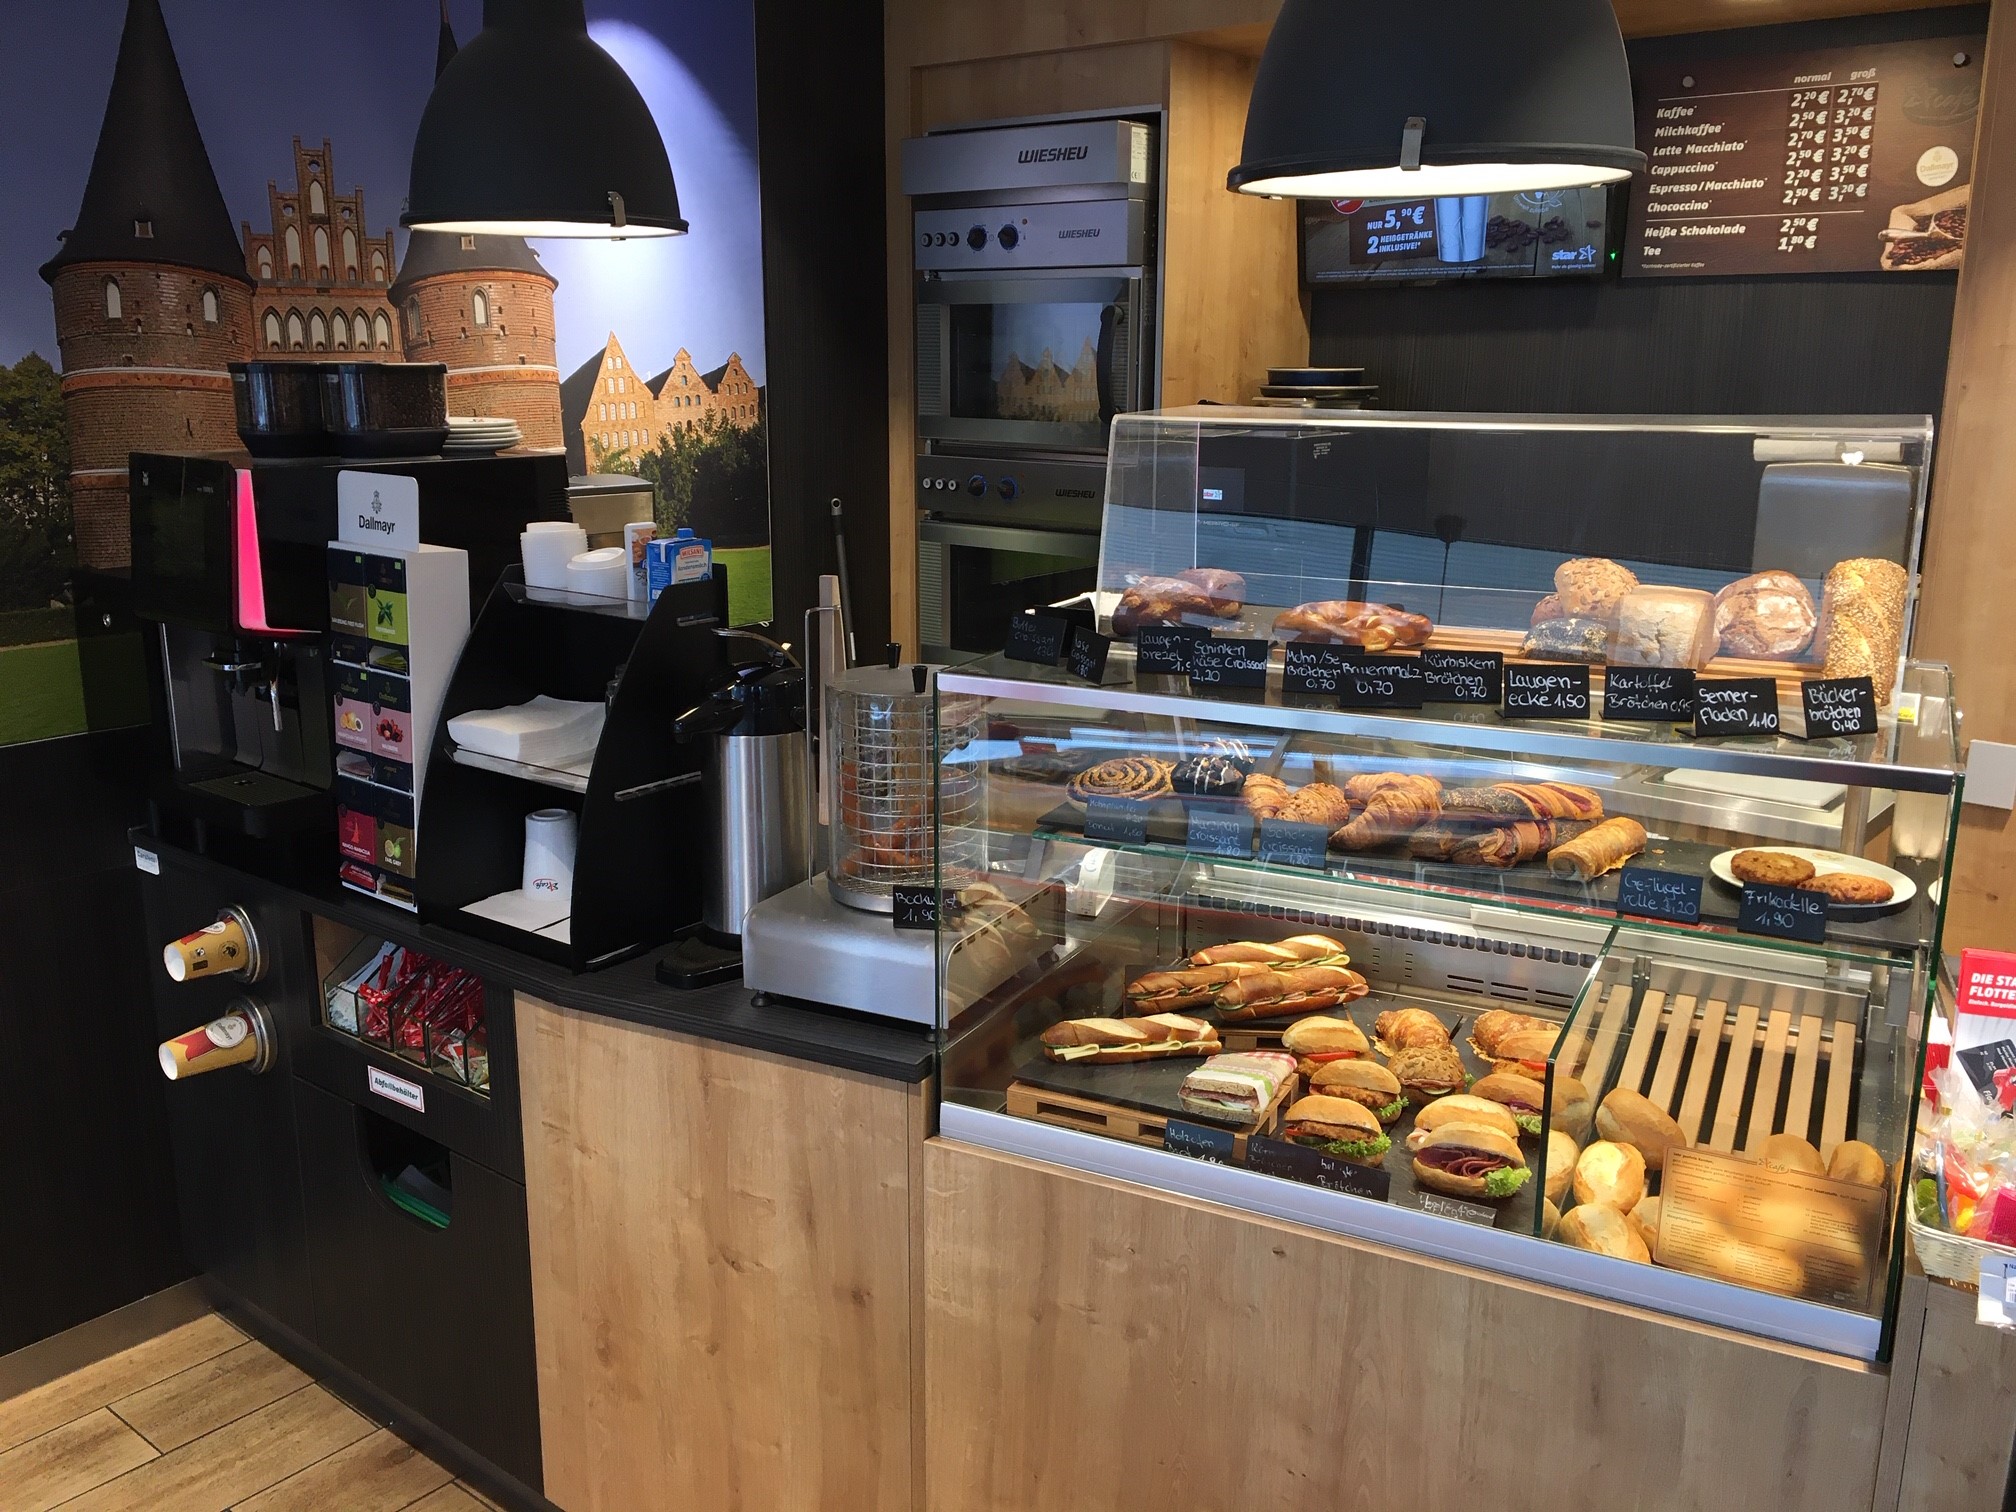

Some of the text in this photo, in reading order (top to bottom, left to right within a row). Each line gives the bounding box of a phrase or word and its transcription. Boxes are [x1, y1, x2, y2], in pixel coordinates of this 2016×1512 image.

[1794, 68, 1876, 84] normal groß
[1018, 145, 1088, 164] WIESHEU
[1653, 145, 1682, 157] Latte
[1367, 221, 1383, 230] NUR
[1644, 226, 1678, 239] Heiße
[1680, 224, 1746, 237] Schokolade
[1058, 228, 1101, 239] WIESHEU
[1367, 236, 1379, 254] 2
[1643, 246, 1662, 256] Tee
[1552, 249, 1578, 260] star
[1055, 488, 1096, 499] WIESHEU
[359, 515, 395, 535] Dallmayr
[1194, 640, 1246, 658] Schinken
[1224, 657, 1267, 671] Croissant
[1191, 669, 1220, 682] 2,20
[1424, 671, 1483, 687] Brötchen
[1609, 673, 1673, 693] Kartoffel
[1306, 678, 1335, 690] 0,70
[1356, 680, 1394, 695] 0,70
[1455, 686, 1487, 700] 0,70
[1508, 692, 1587, 709] ecke 1,50
[1808, 684, 1867, 704] Bäcker-
[1606, 693, 1668, 710] Brötchen
[1749, 712, 1778, 729] 1,10
[1831, 719, 1860, 732] 0,40
[1744, 889, 1823, 915] Frikadelle
[1755, 911, 1795, 928] 1,90
[1971, 972, 1995, 985] DIE
[375, 1077, 418, 1100] Abfallbehälter
